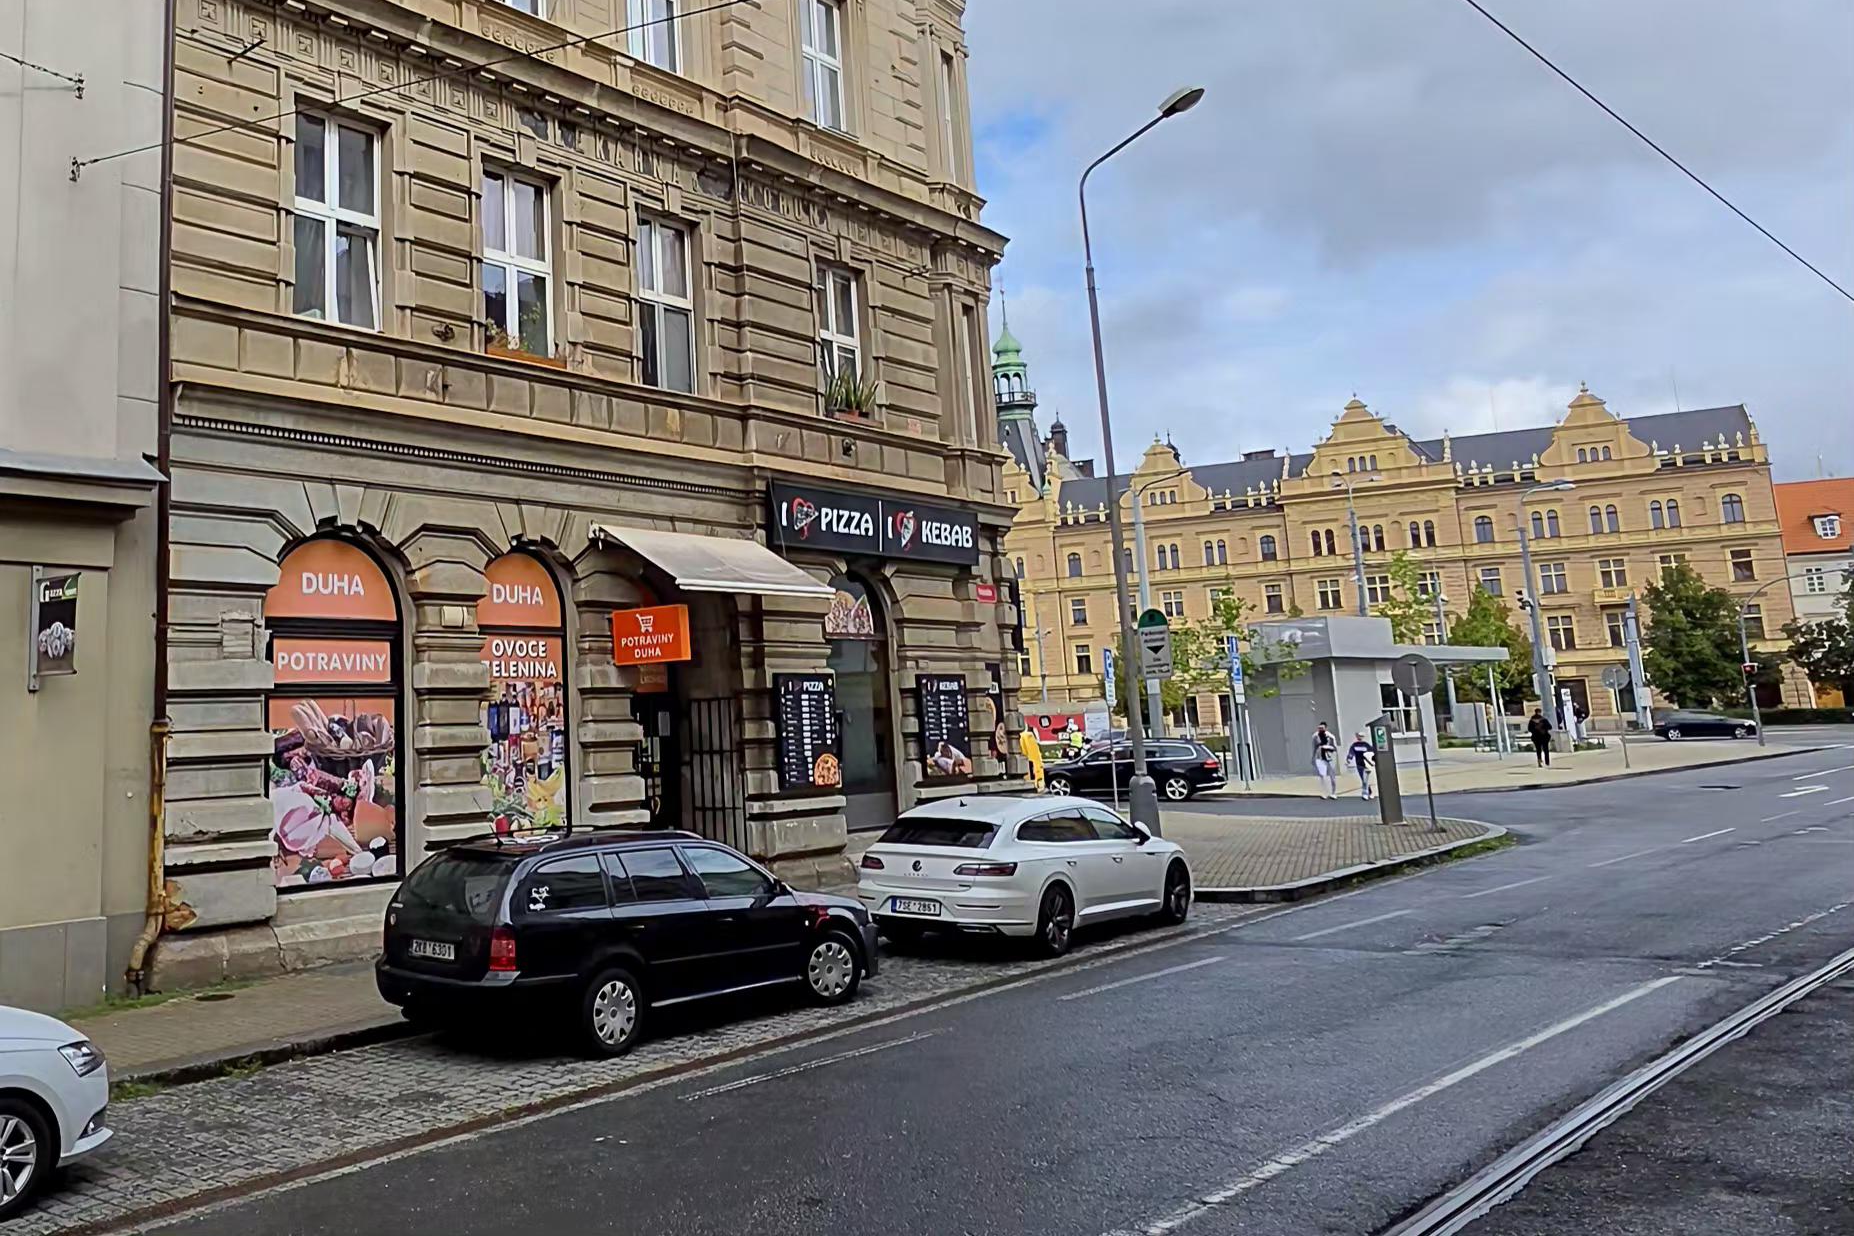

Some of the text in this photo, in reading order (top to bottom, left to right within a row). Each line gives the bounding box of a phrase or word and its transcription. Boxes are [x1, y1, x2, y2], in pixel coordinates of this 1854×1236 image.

[781, 501, 973, 548] I PIZZA I KEBAB
[302, 572, 365, 595] DUHA
[492, 583, 544, 606] DUHA
[491, 639, 547, 658] OVOCE
[621, 633, 674, 648] POTRAVINY
[277, 651, 387, 672] POTRAVINY
[634, 647, 662, 658] DUHA
[803, 681, 824, 692] PIZZA
